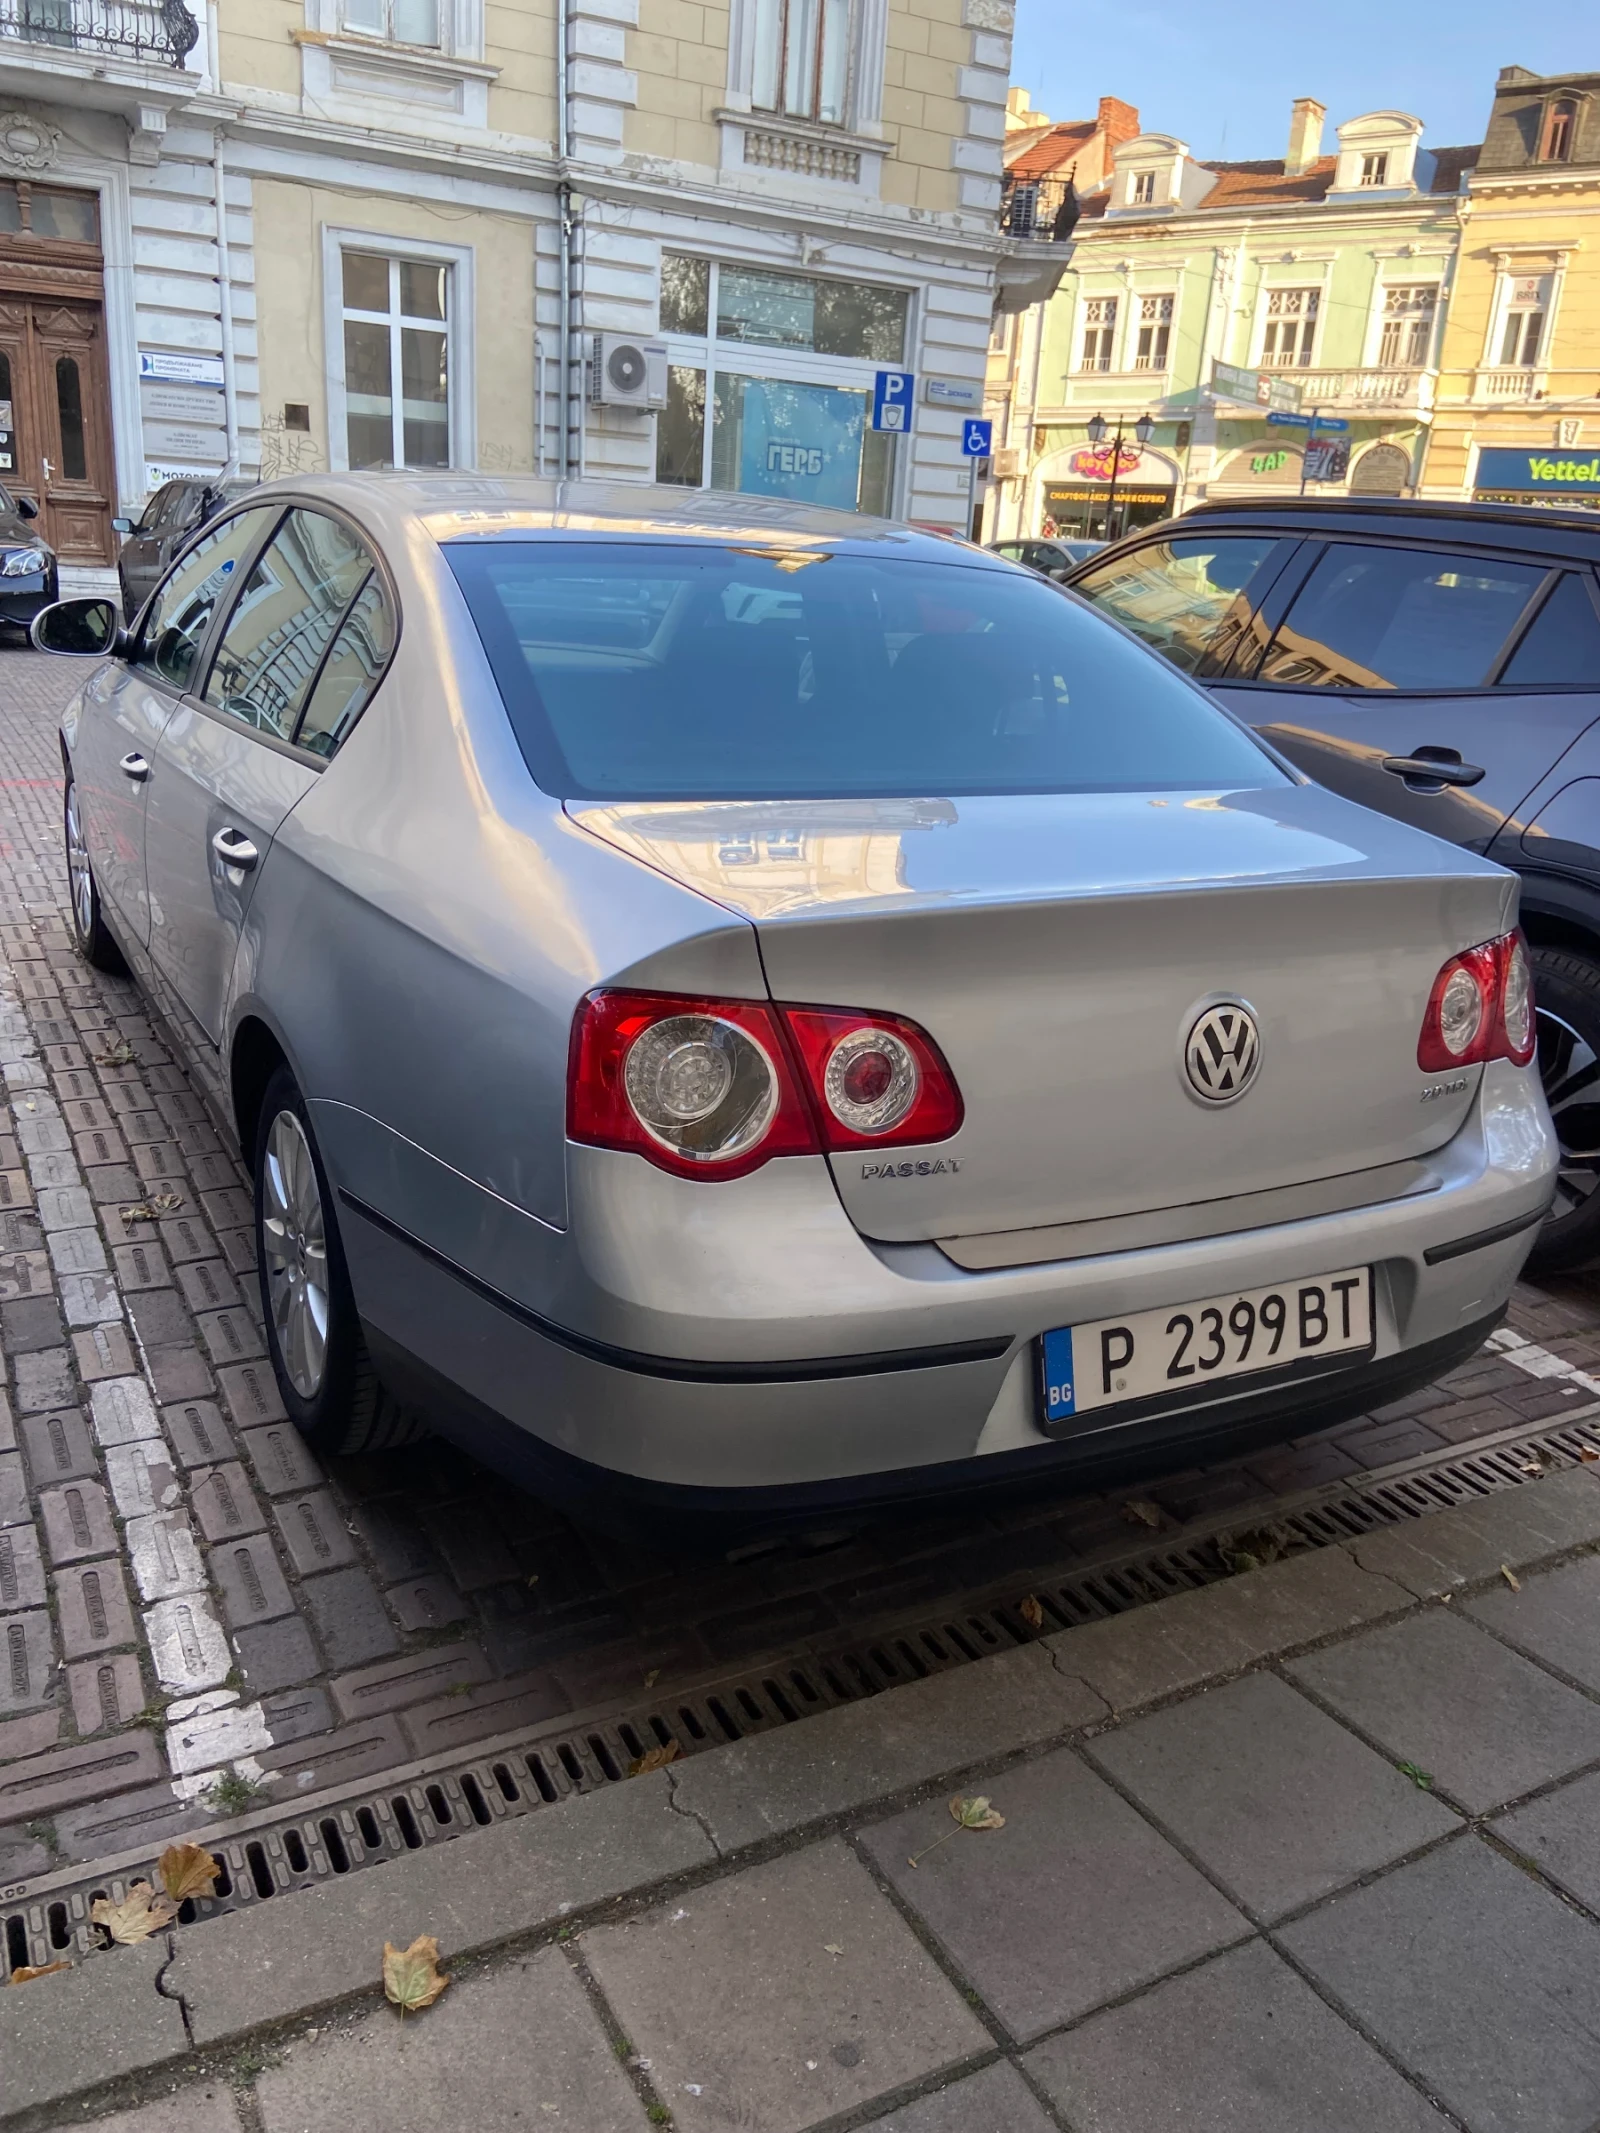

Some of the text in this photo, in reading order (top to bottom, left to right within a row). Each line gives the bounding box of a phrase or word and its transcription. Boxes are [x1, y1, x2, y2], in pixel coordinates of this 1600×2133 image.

[885, 374, 904, 401] P
[768, 444, 822, 475] ГЕРБ
[862, 1158, 965, 1179] PASSAT
[1101, 1278, 1360, 1394] P 2399 BT
[1050, 1383, 1072, 1406] BG
[0, 1885, 27, 1900] CO
